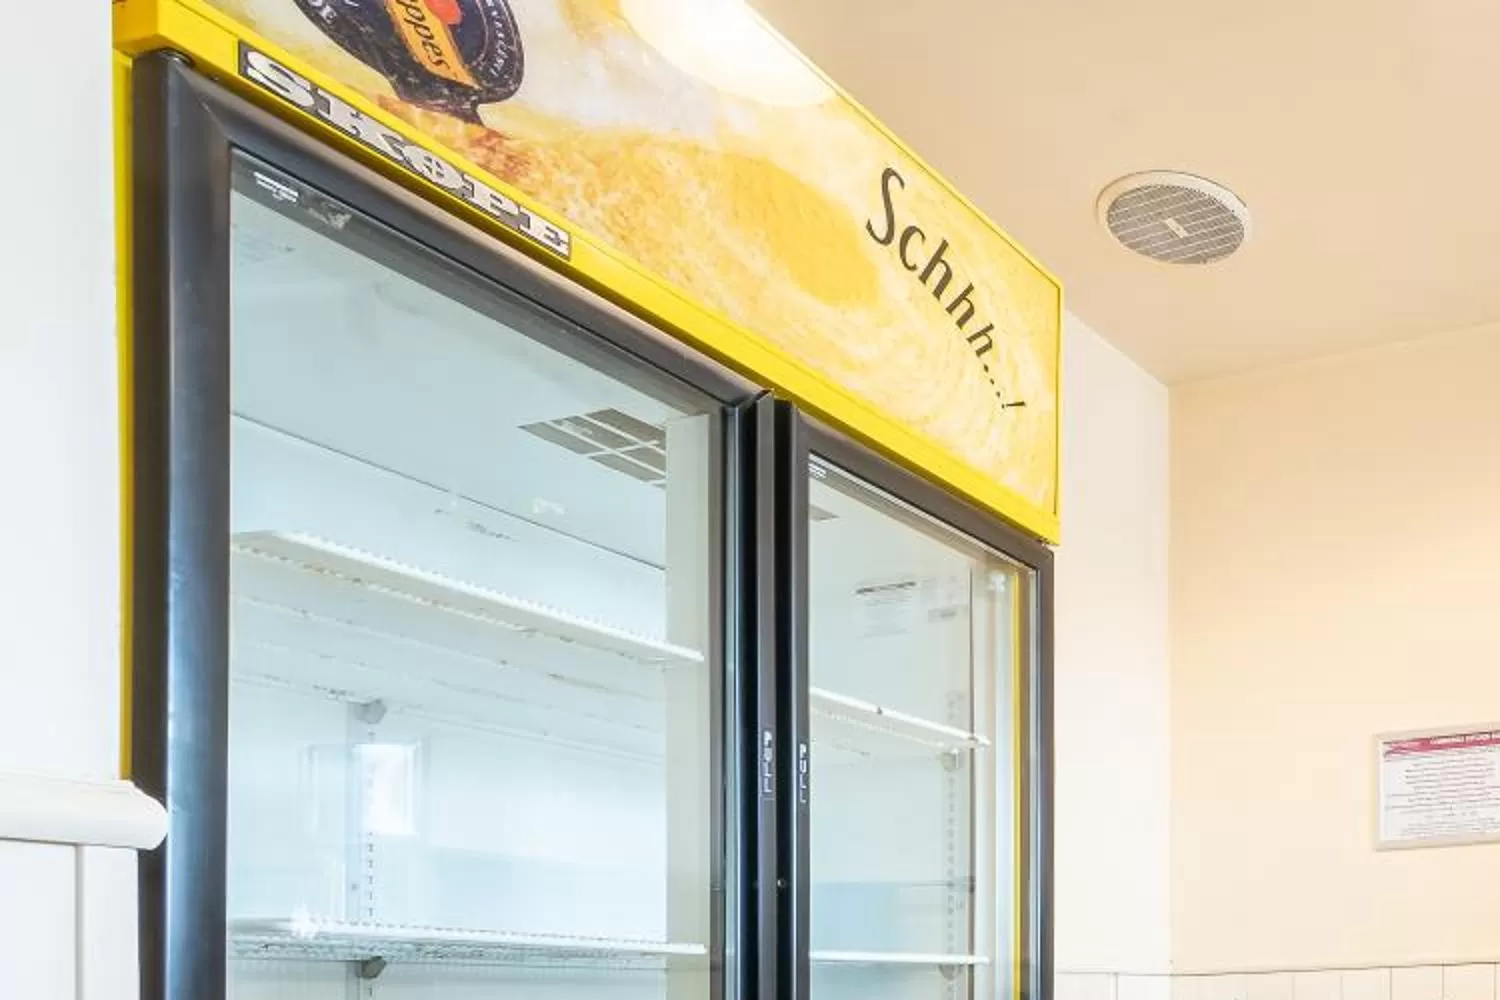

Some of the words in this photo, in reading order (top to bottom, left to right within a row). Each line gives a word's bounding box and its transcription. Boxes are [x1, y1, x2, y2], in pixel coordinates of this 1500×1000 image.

[396, 0, 450, 70] ppes
[246, 50, 570, 255] SKOPE
[799, 743, 807, 803] PULL
